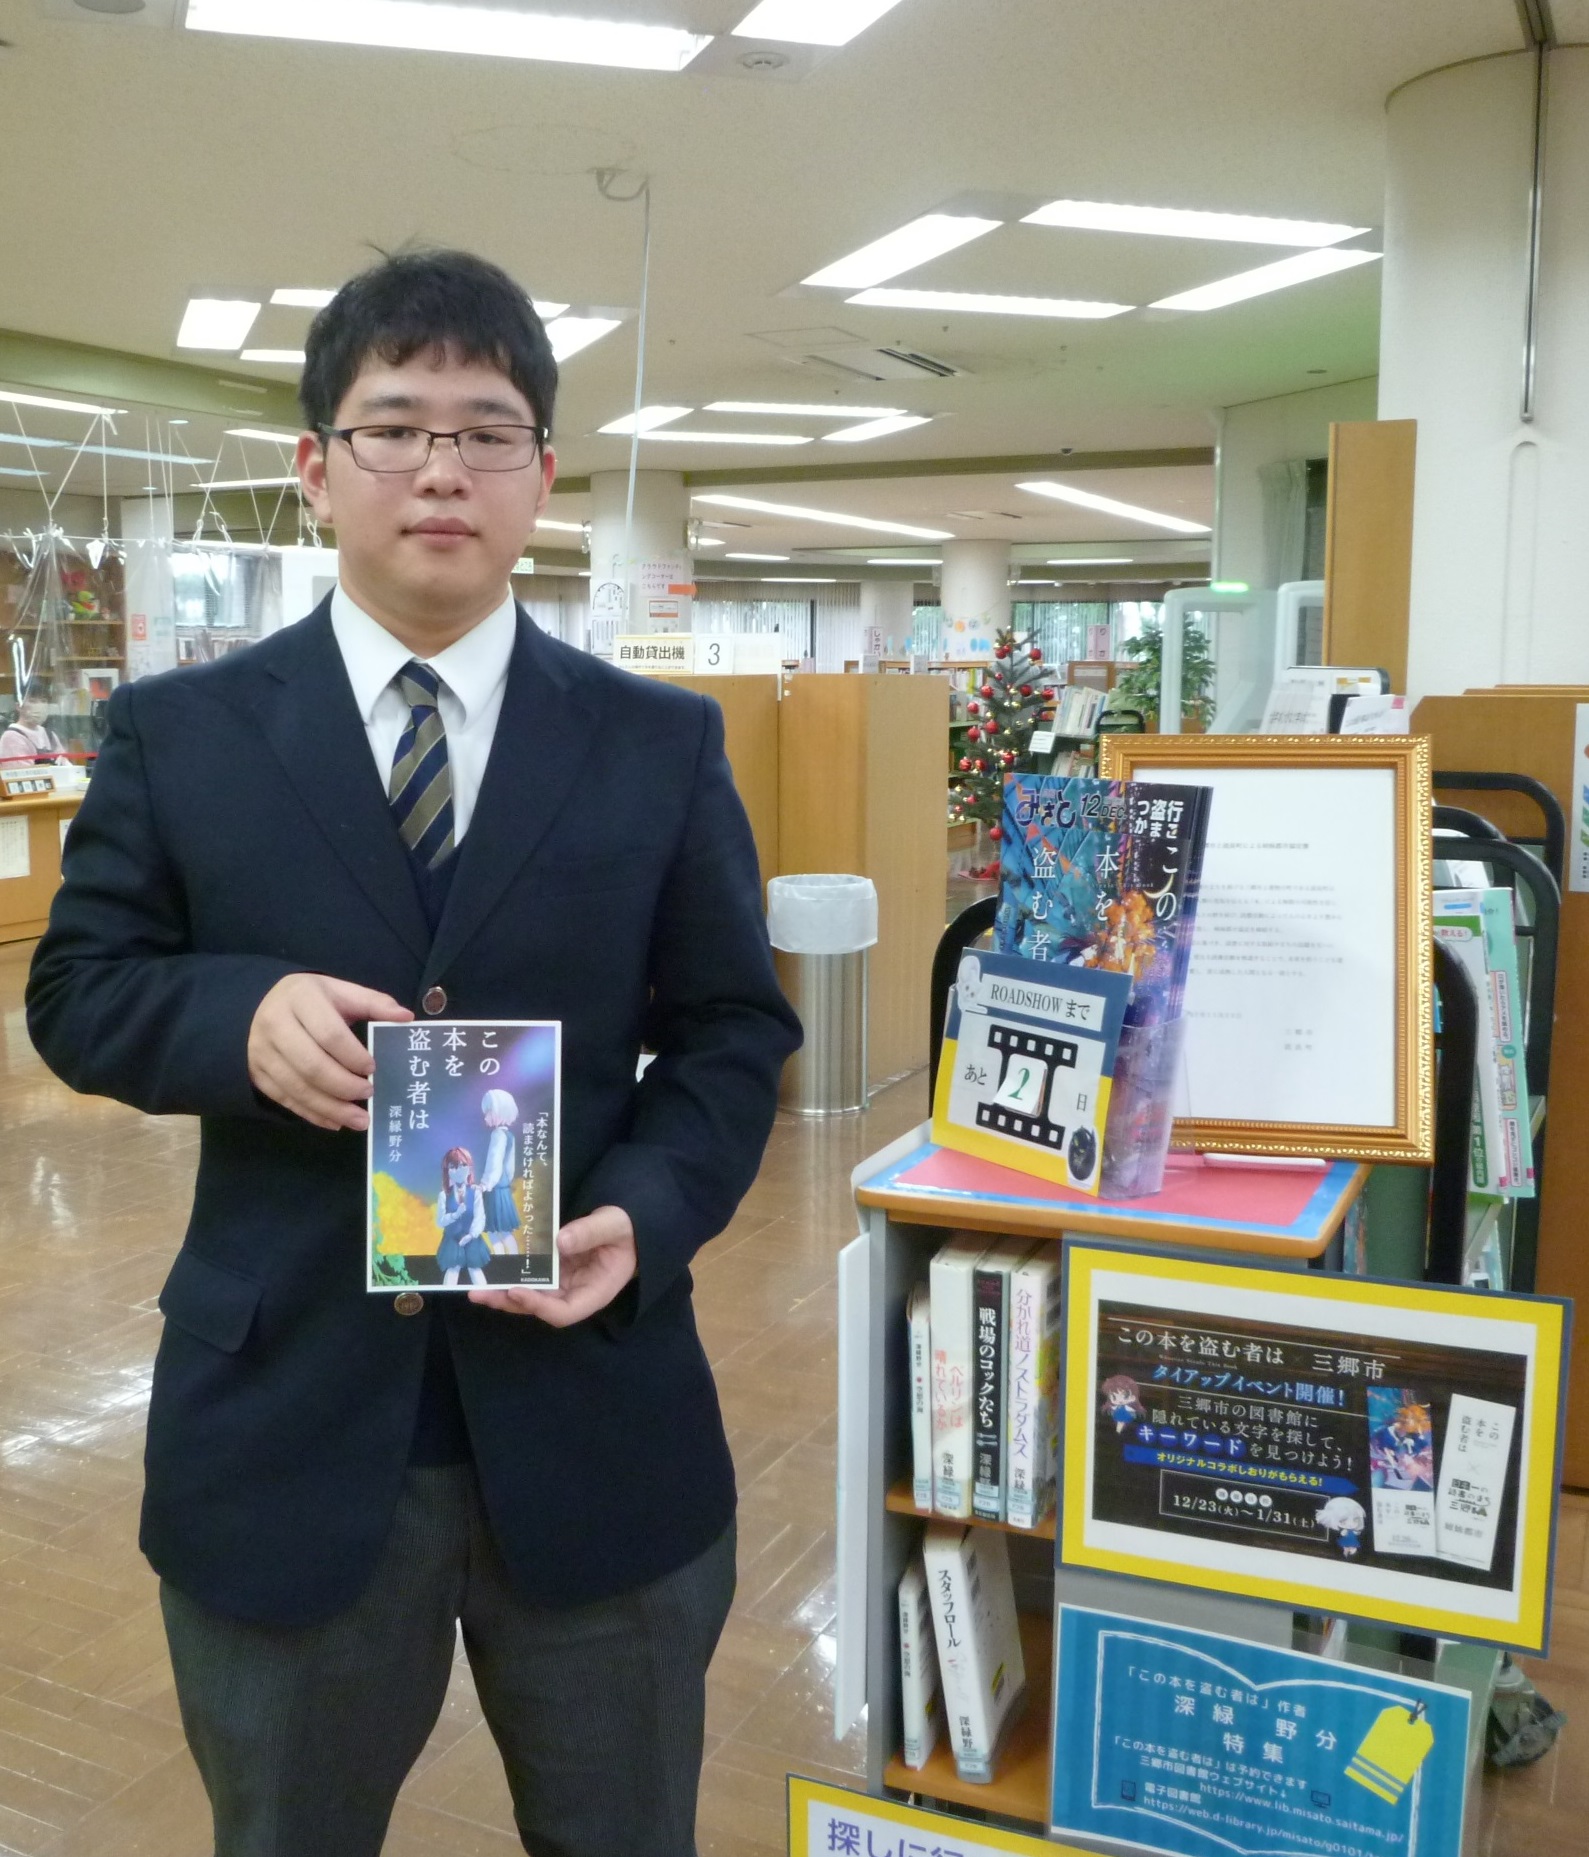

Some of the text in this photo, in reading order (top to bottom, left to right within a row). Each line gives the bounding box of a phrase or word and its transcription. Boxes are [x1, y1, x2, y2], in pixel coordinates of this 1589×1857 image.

[620, 645, 685, 660] 自動貸出機
[707, 643, 721, 666] 3
[1080, 793, 1101, 818] 12
[1095, 845, 1119, 921] 本を
[1156, 846, 1178, 921] この
[442, 1028, 467, 1076] 本を
[480, 1031, 500, 1076] この
[406, 1028, 432, 1130] 盗む者は
[964, 1063, 1088, 1111] あと 2 日
[388, 1105, 403, 1162] 深緑野分
[978, 1307, 996, 1428] 戦場のコックたち
[1013, 1288, 1032, 1458] 分かれ道ノストラダムス
[1118, 1327, 1386, 1381] この本を盗む者は 三郷市
[1152, 1364, 1345, 1406] タイアップイベント開催！
[1152, 1409, 1342, 1452] 隠れている文字を探して、
[1177, 1396, 1318, 1428] 三郷市の図書館に
[1157, 1452, 1323, 1487] オリジナルコラボしおりがもらえる！
[938, 1569, 961, 1649] スタッフロール
